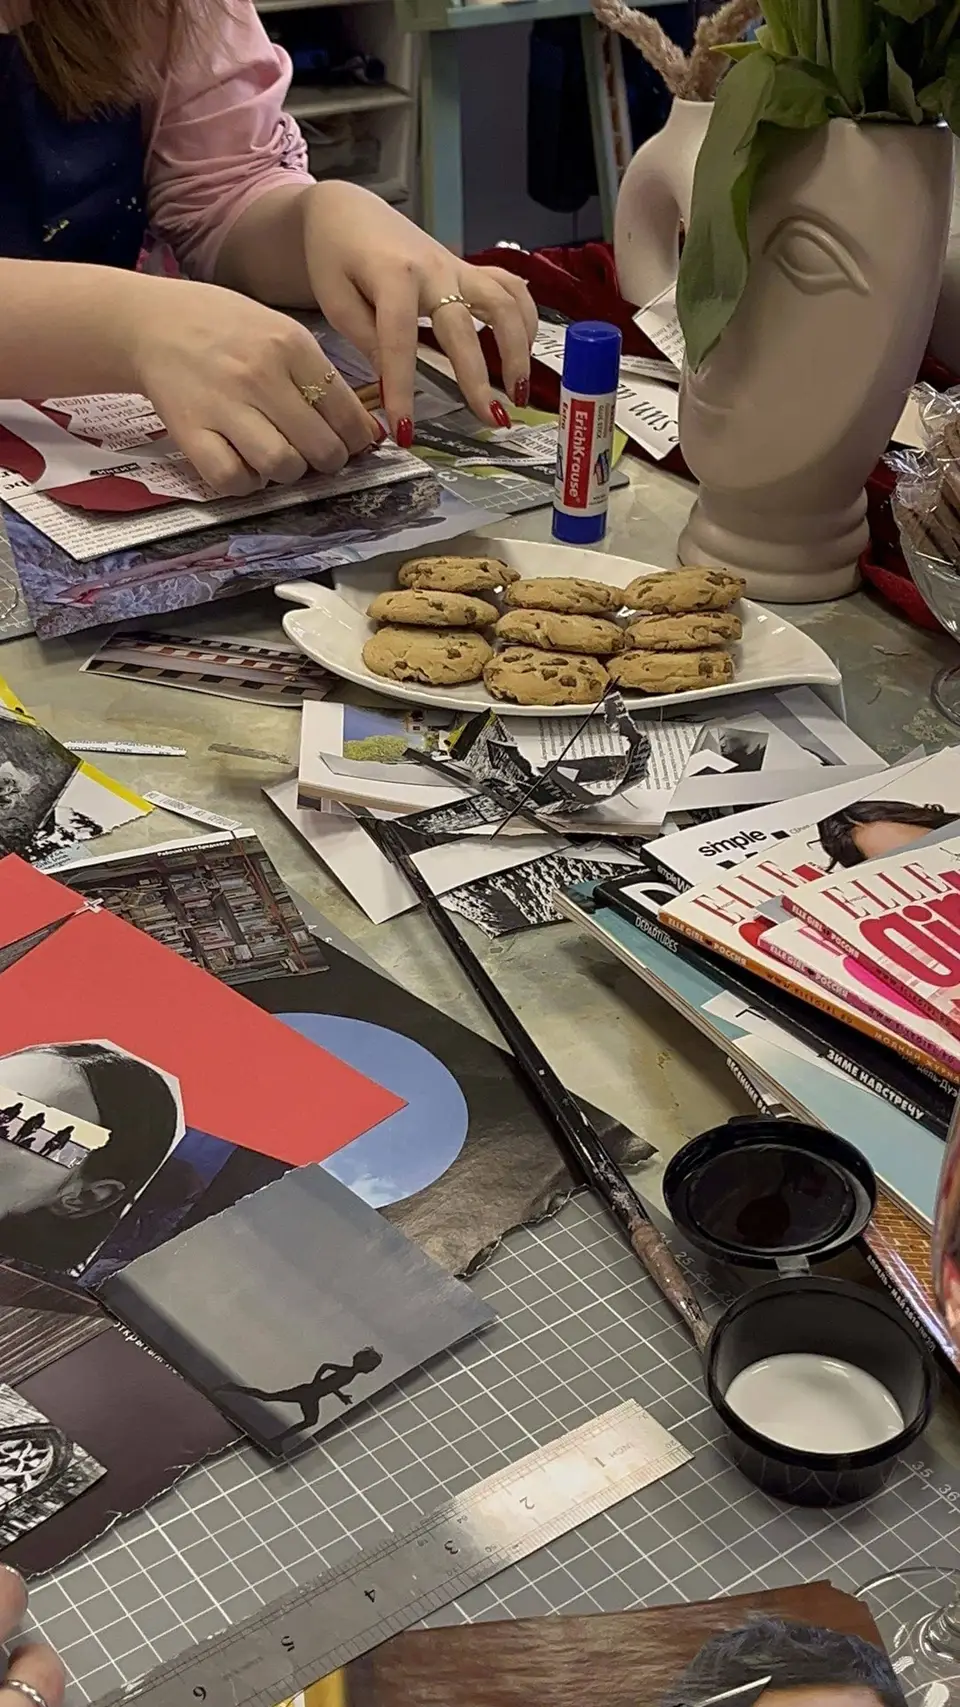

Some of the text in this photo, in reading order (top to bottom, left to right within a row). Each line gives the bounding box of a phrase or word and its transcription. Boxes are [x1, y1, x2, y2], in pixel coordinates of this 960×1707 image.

[569, 410, 588, 498] ErichKrause
[698, 830, 767, 857] simple
[689, 860, 807, 927] ELLE
[820, 862, 952, 919] ELLE
[668, 918, 705, 942] ELLE GIRL
[792, 905, 823, 932] ELLE GIRL
[634, 915, 679, 953] DEPARTURES
[713, 942, 748, 966] РОССИЯ
[831, 934, 860, 959] РОССИЯ
[770, 945, 806, 974] ELLE GIRL
[815, 971, 849, 997] РОССИЯ
[926, 1059, 960, 1084] ЖУРНА
[827, 1049, 925, 1121] ЗИМЕ НАВСТРЕЧУ
[674, 1251, 696, 1266] 25
[594, 1456, 606, 1469] 1
[911, 1460, 935, 1478] 35
[519, 1496, 536, 1511] 2
[938, 1483, 960, 1502] 36
[443, 1540, 459, 1555] 3
[364, 1588, 377, 1603] 4
[280, 1635, 295, 1652] 5
[192, 1685, 207, 1701] 6
